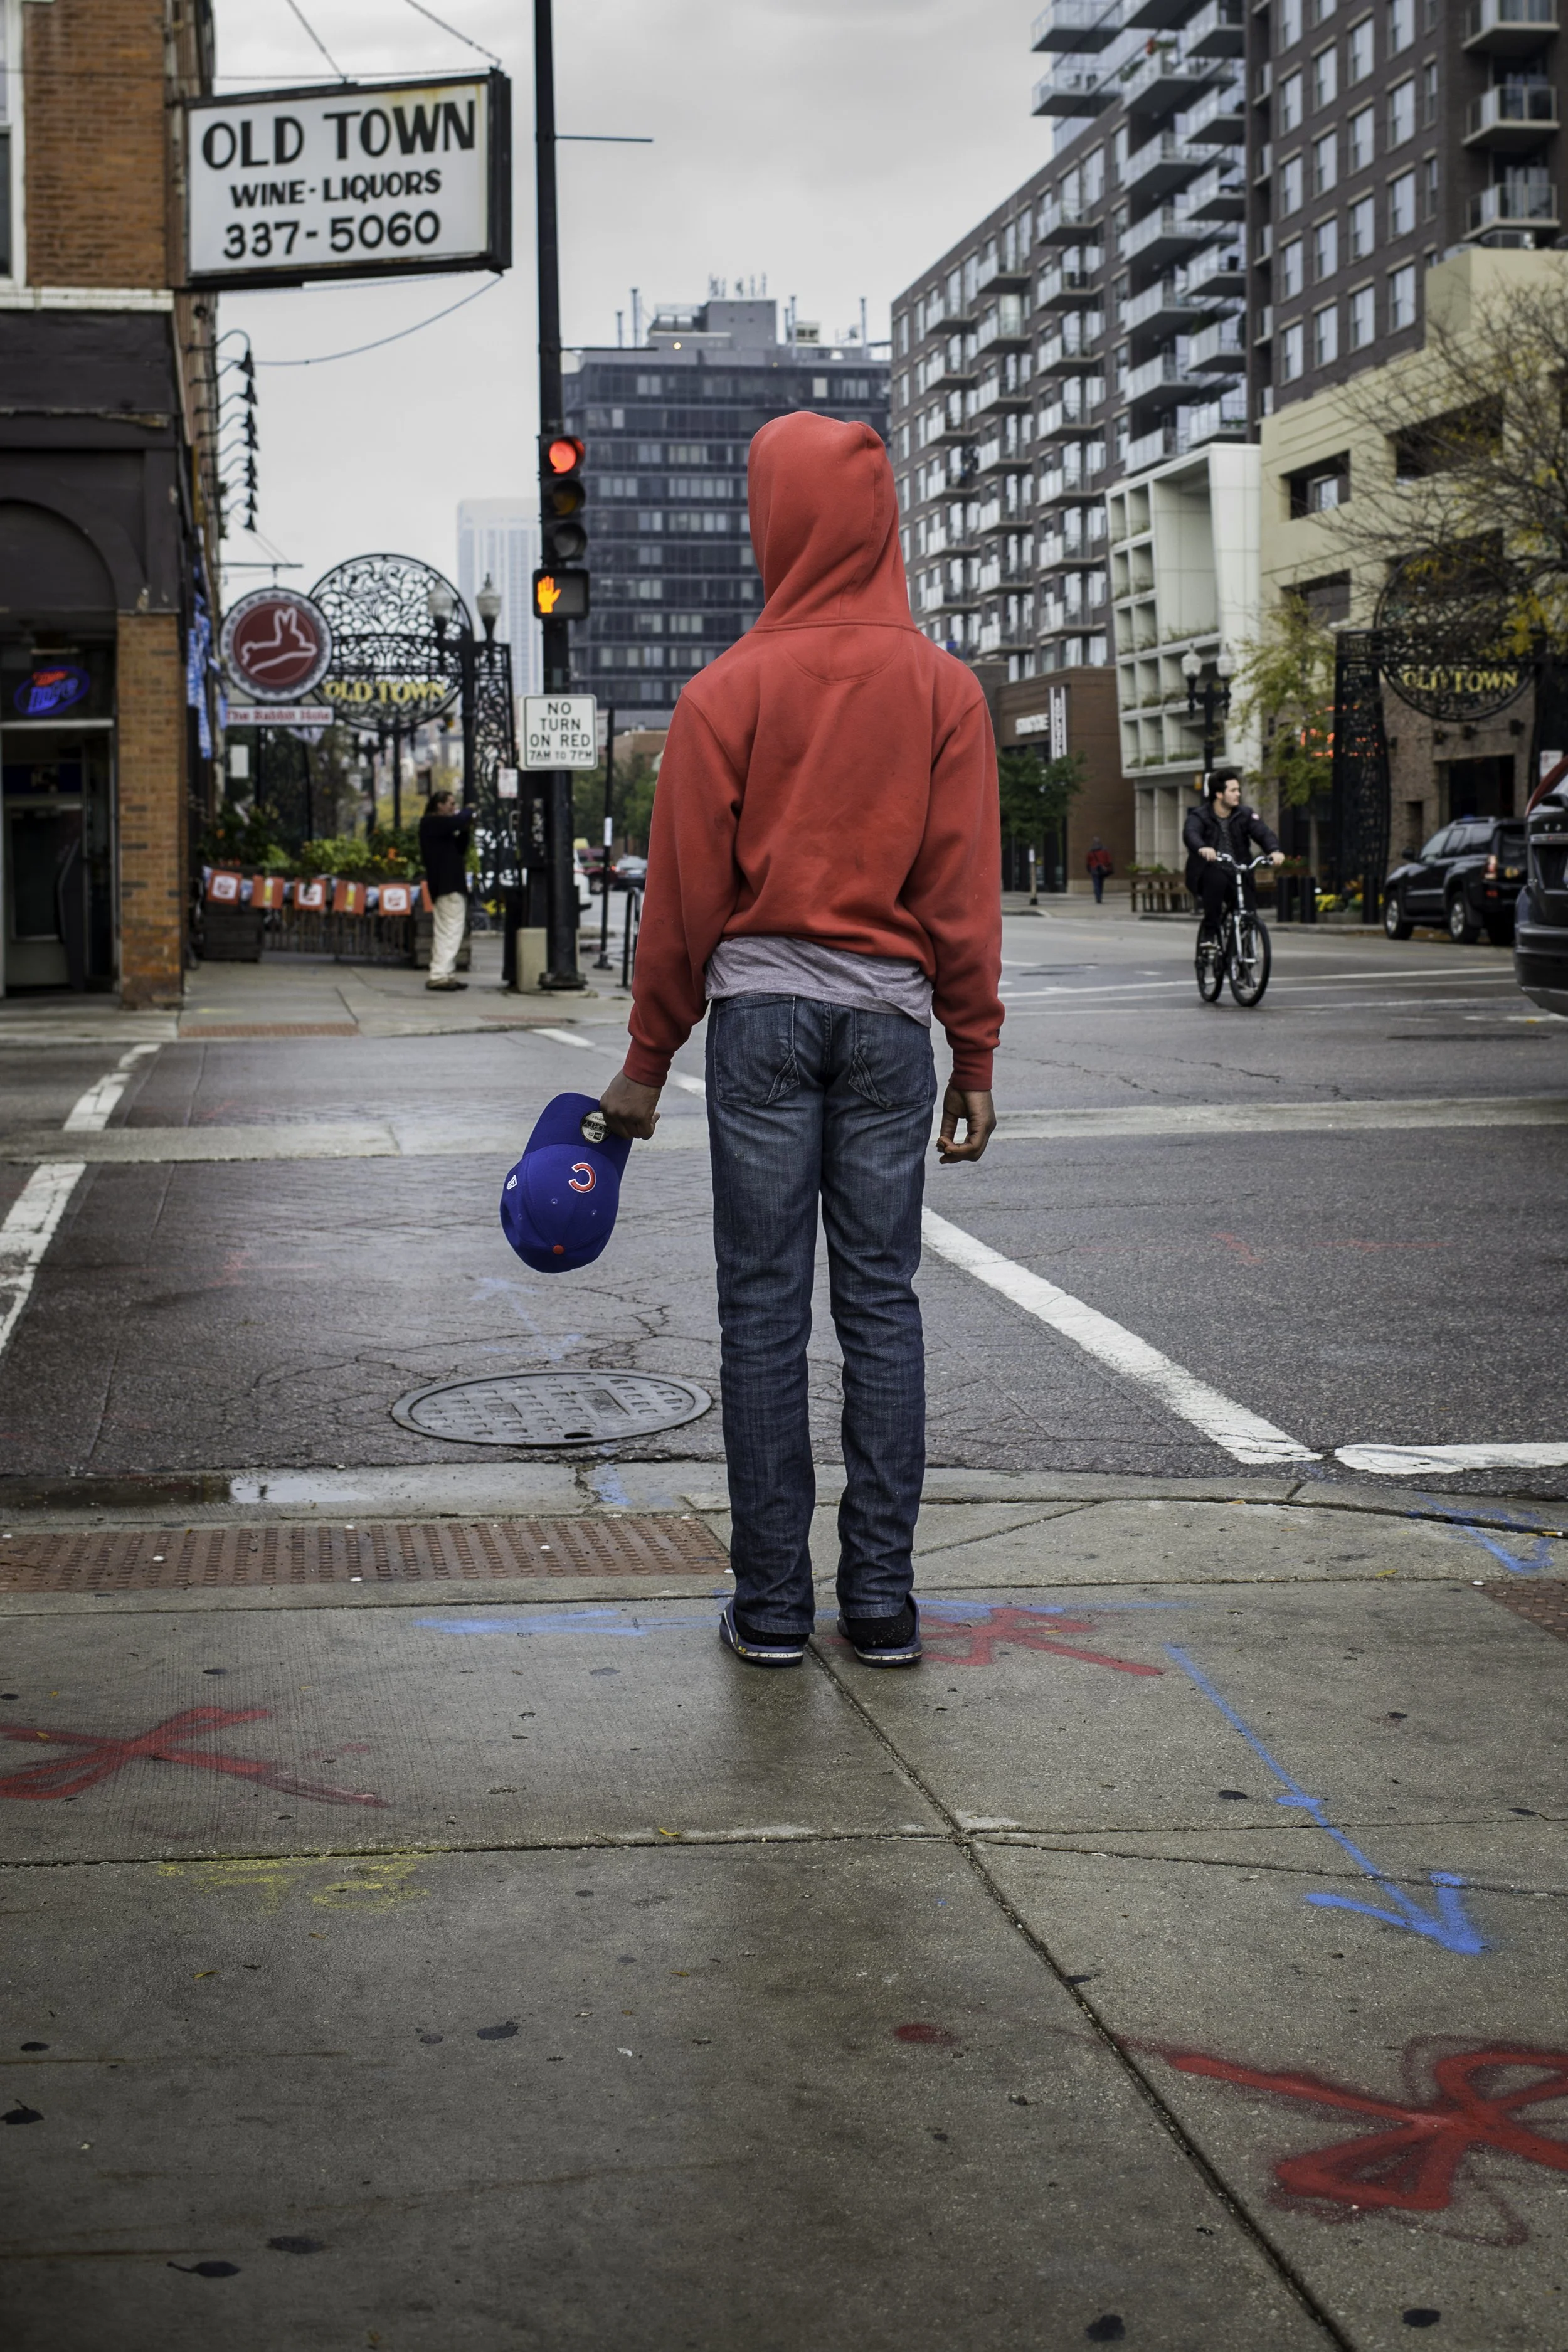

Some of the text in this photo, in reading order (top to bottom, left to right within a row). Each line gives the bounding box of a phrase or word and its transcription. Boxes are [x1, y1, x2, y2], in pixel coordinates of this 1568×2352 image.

[201, 100, 475, 171] OLD TOWN
[223, 210, 441, 260] 337-5060
[324, 681, 446, 704] OLD TOWN
[1450, 670, 1518, 693] TOWN
[548, 702, 571, 715] NO
[540, 718, 580, 731] TURN
[530, 734, 590, 747] ON RED
[568, 1162, 597, 1194] C
